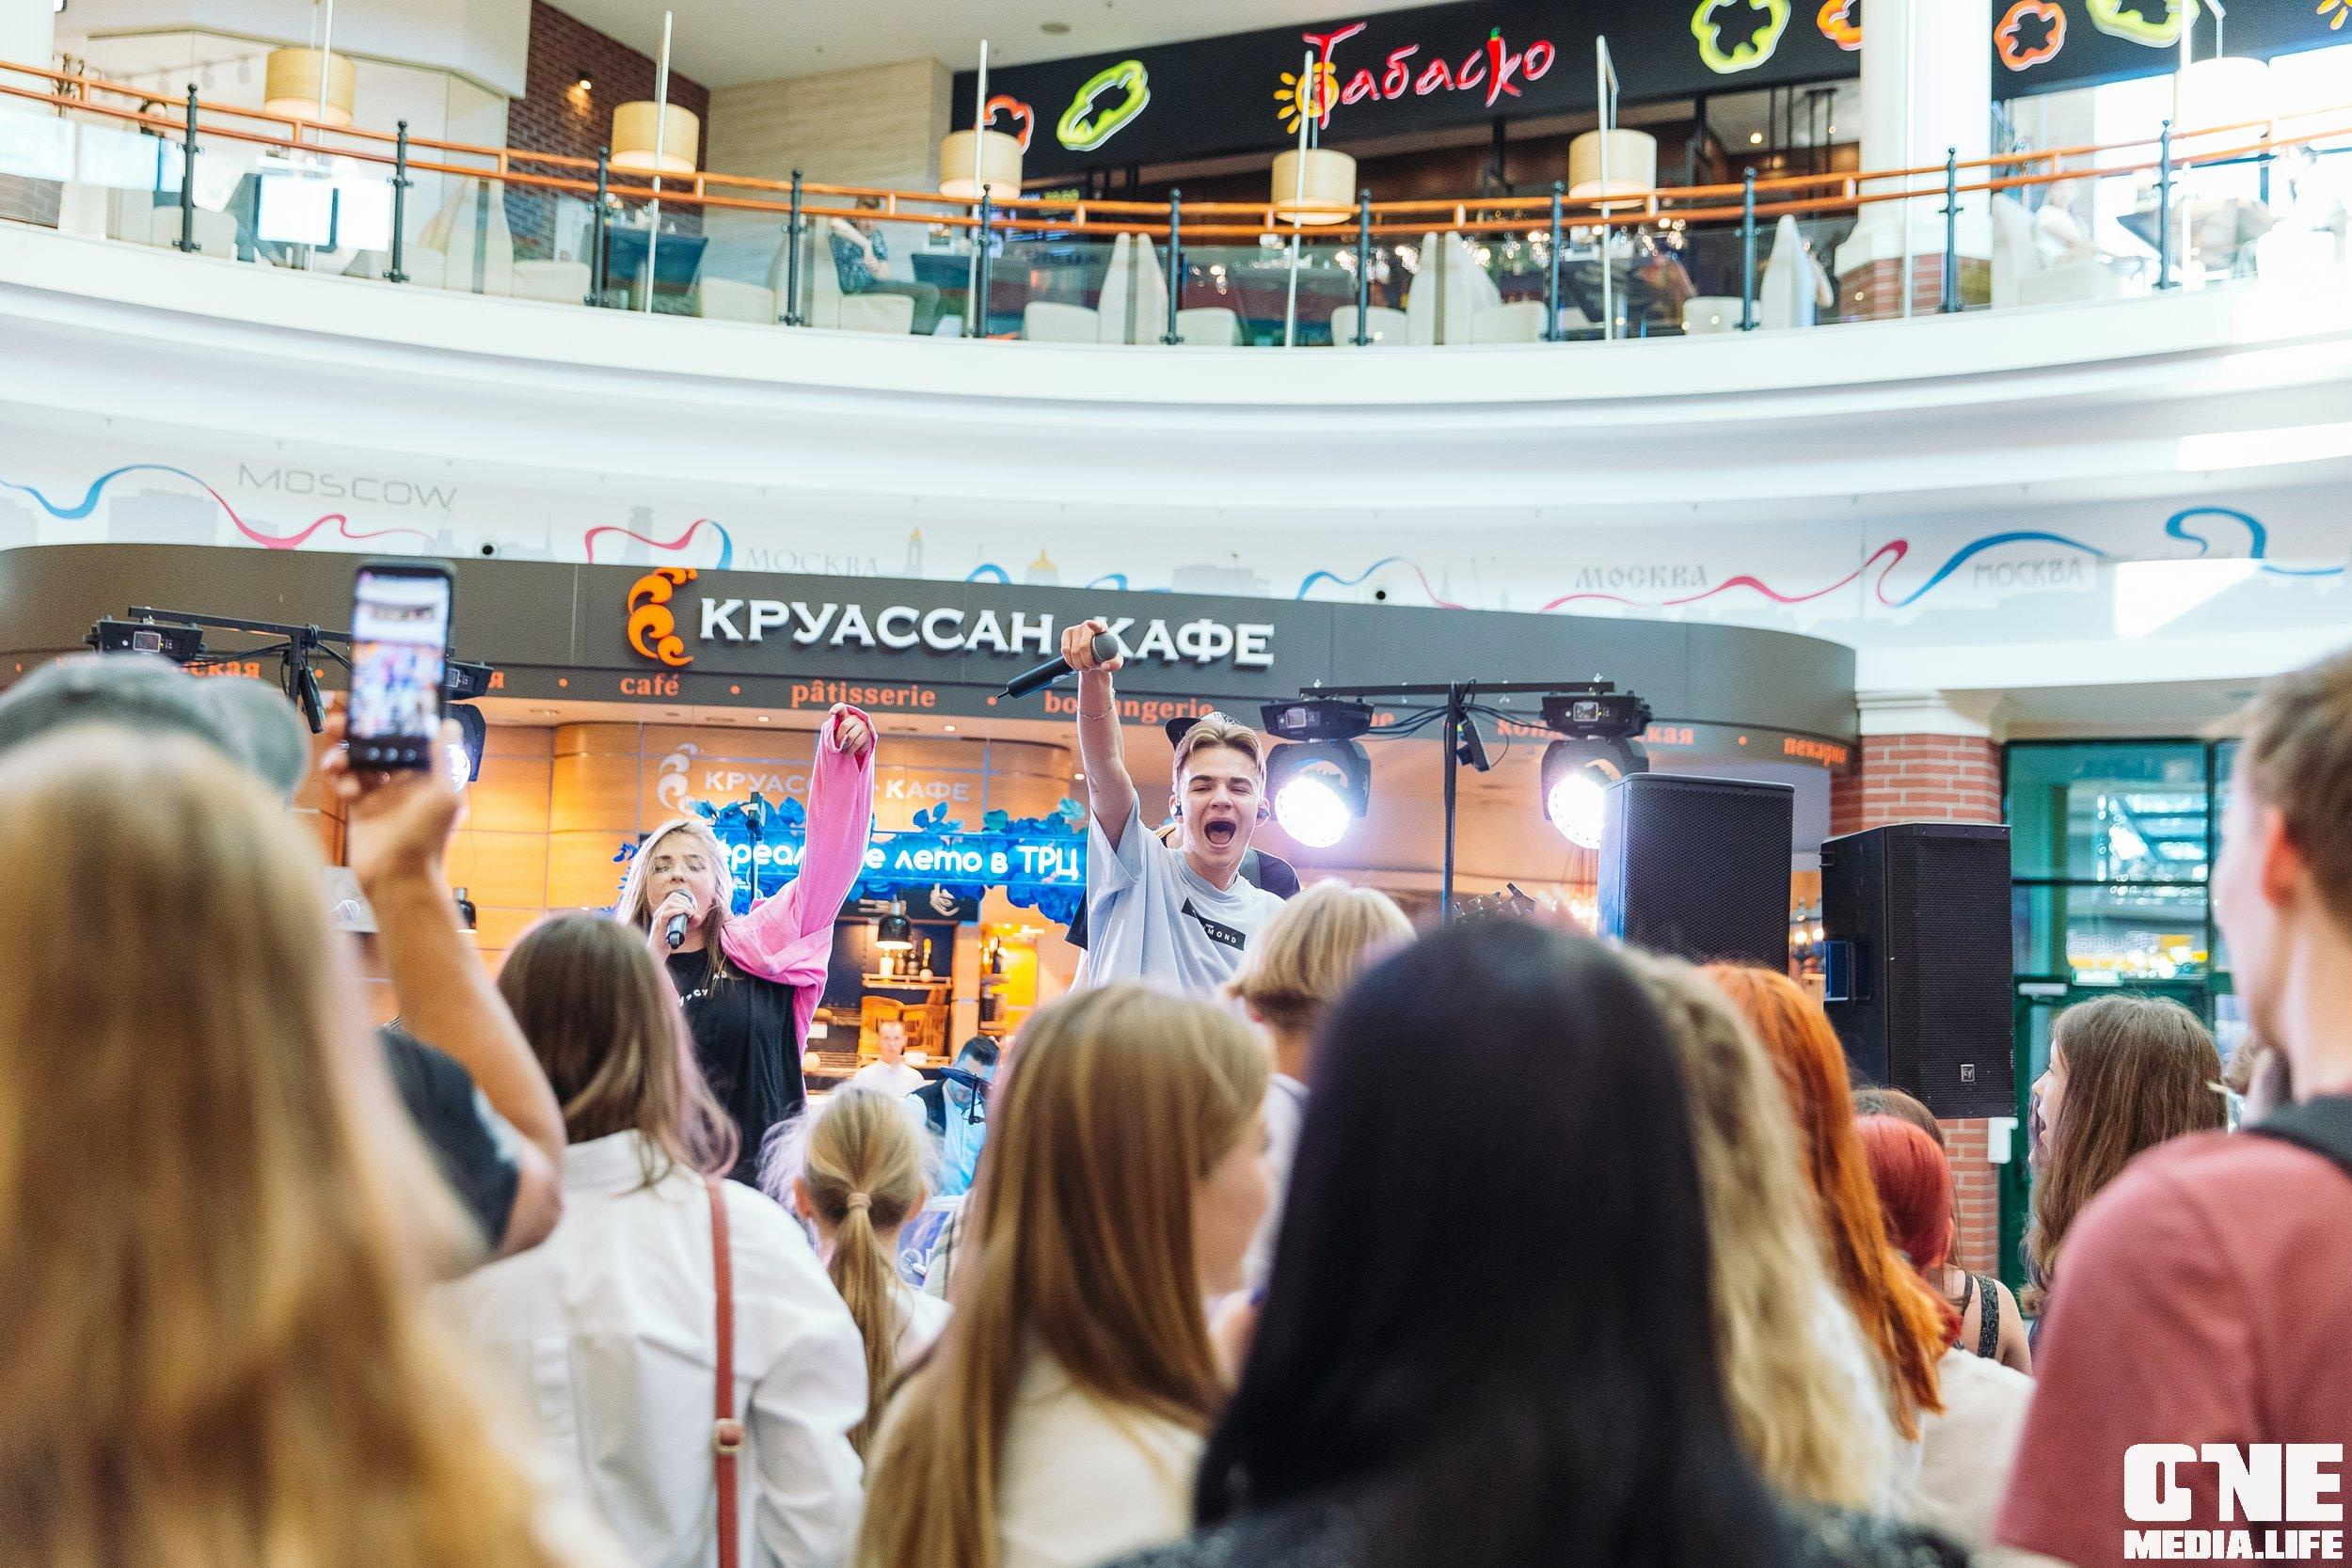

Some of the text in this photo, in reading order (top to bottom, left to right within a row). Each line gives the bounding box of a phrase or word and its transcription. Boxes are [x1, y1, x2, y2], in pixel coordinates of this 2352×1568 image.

[1302, 21, 1555, 130] Табаско
[239, 463, 459, 508] MOSCOW
[1575, 563, 1708, 589] МОСКВА
[699, 596, 1055, 657] КРУАССАН
[620, 673, 679, 696] café
[791, 680, 936, 708] pâtisserie
[885, 779, 970, 800] КАФЕ
[894, 848, 983, 873] лето
[991, 851, 1009, 874] в
[1016, 845, 1079, 880] ТРЦ
